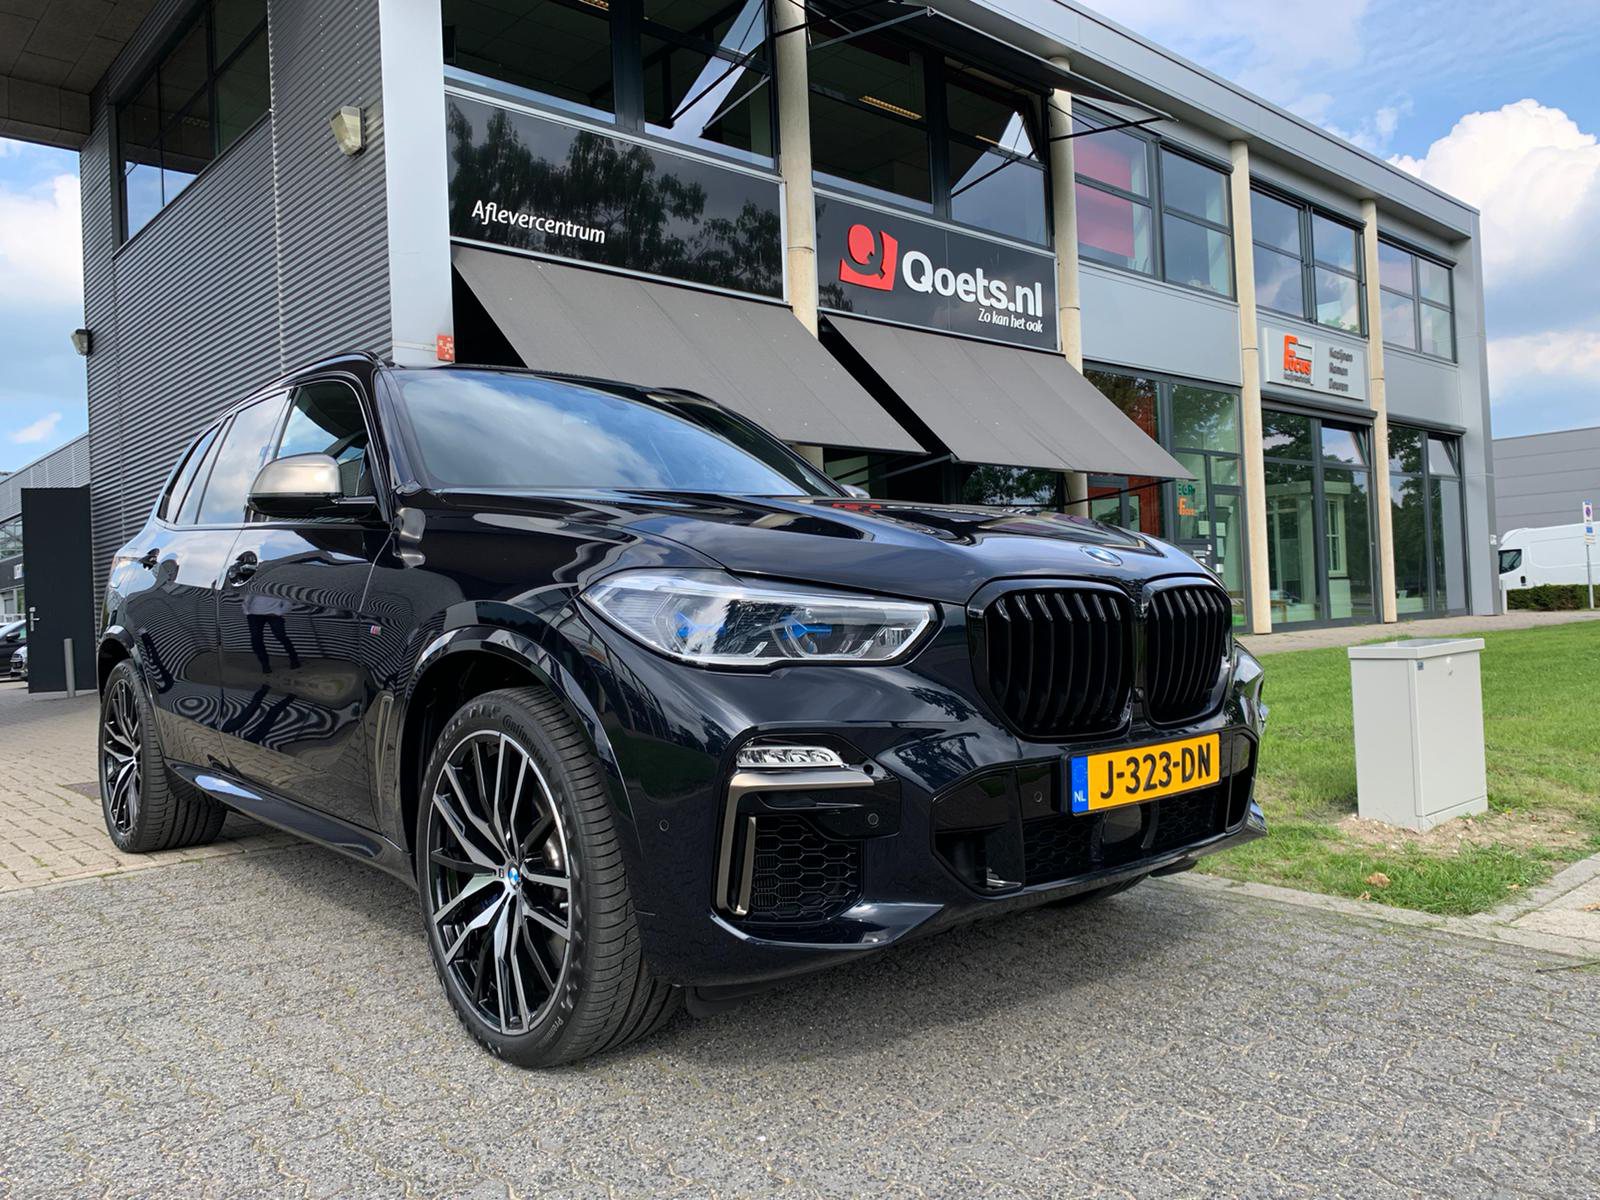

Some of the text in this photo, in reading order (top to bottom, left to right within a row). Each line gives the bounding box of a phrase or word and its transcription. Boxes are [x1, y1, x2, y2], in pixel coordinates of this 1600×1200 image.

[471, 200, 606, 244] Aflevercentrum
[902, 251, 1043, 317] Qoets.nl
[978, 308, 1043, 333] Zo kan het ook
[1074, 742, 1211, 802] NL J-323-DN
